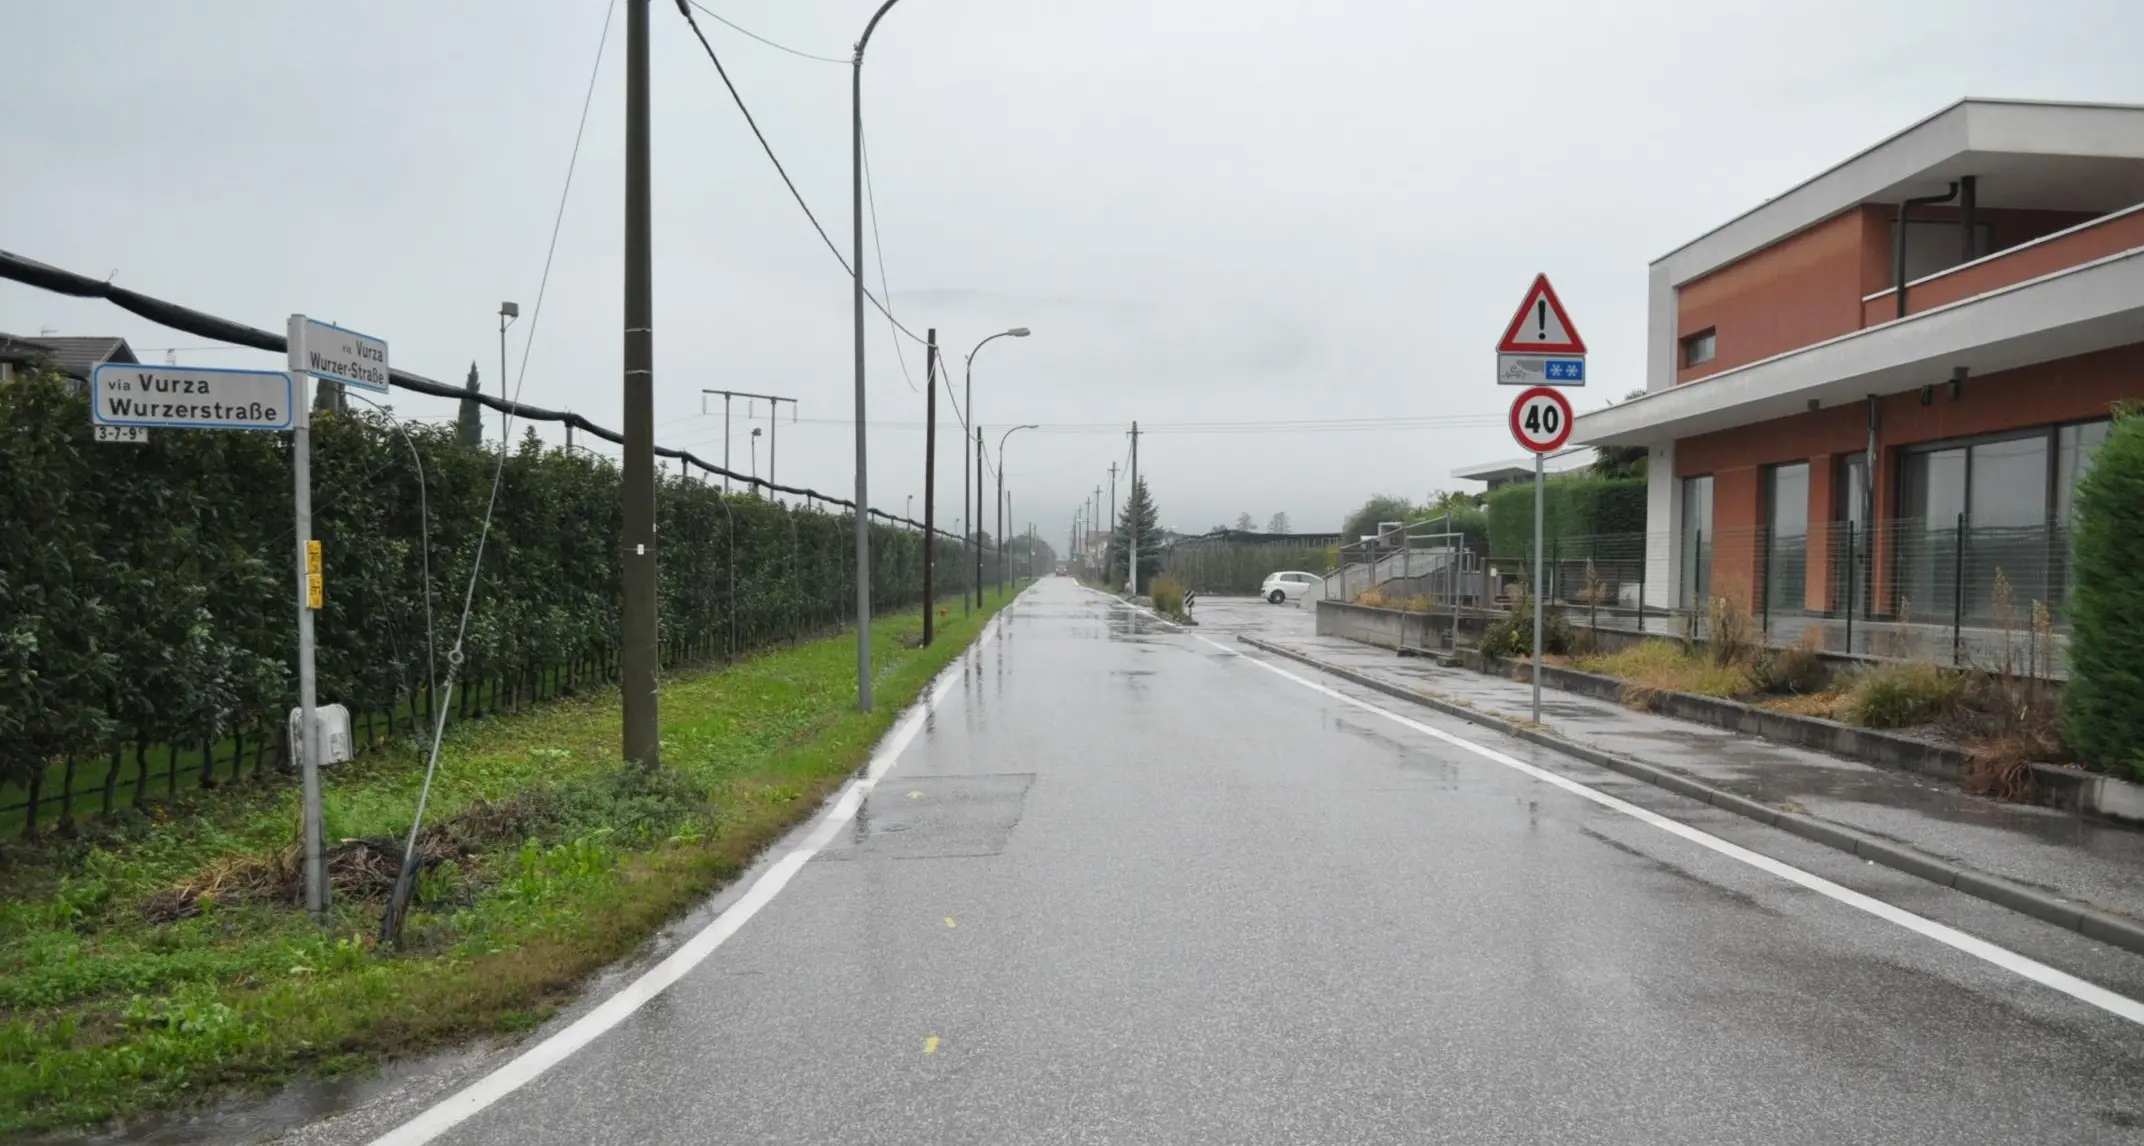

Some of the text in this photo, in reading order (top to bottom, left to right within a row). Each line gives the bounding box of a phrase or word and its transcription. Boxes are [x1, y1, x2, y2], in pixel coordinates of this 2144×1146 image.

[356, 339, 383, 363] Vurza
[310, 350, 384, 385] Wurzer-Straße
[108, 373, 210, 394] via Vurza
[109, 397, 277, 421] Wurzerstraße
[1525, 405, 1558, 433] 40
